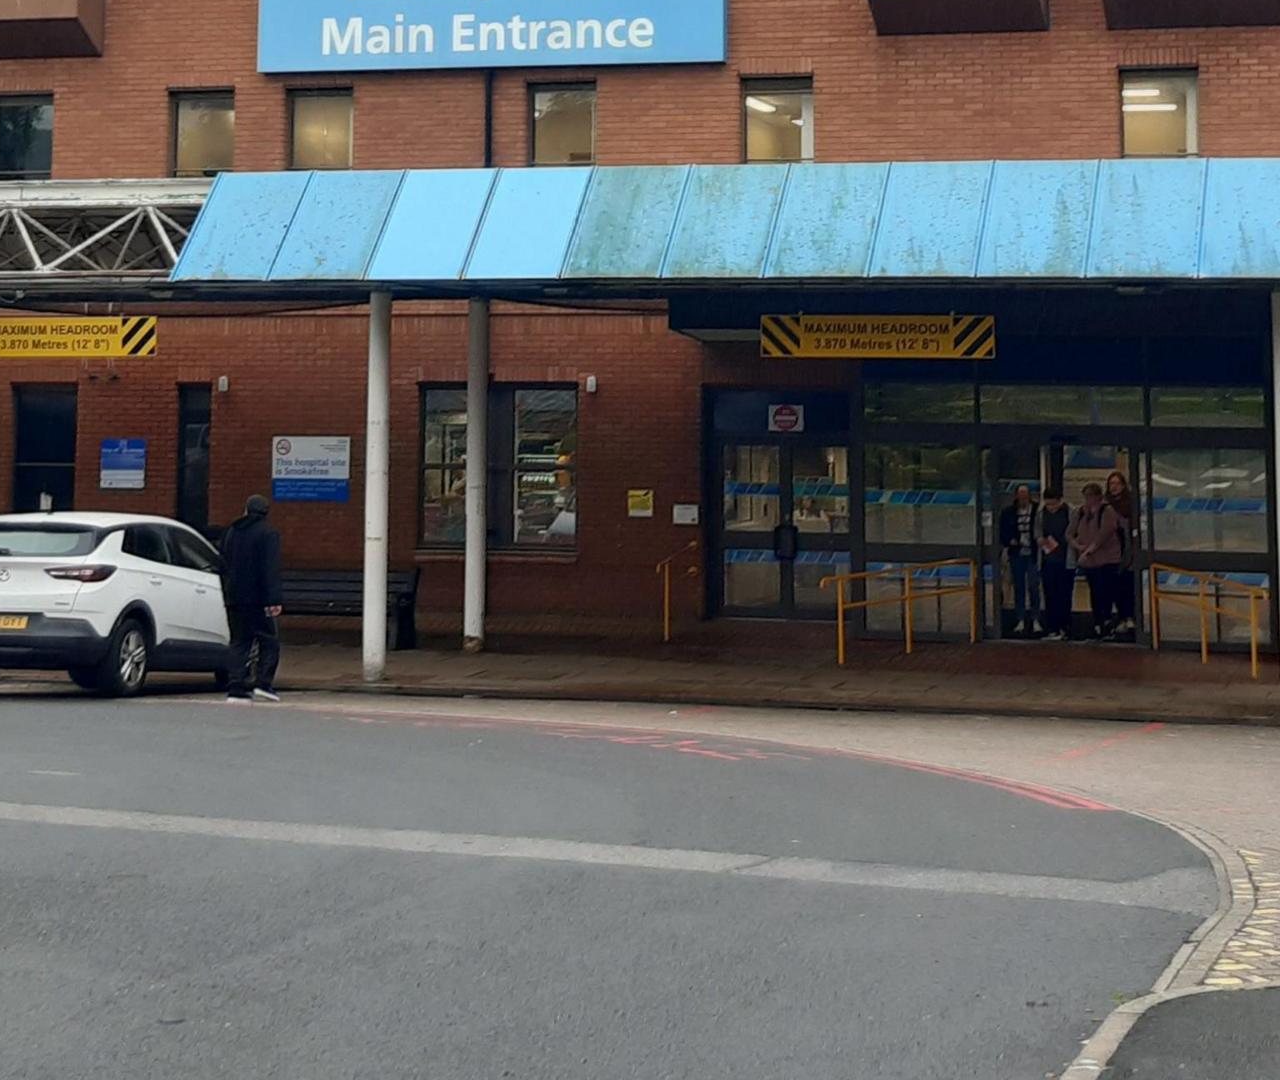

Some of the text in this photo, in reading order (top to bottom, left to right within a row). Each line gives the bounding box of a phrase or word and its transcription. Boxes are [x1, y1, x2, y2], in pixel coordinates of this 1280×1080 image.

[321, 13, 655, 56] Main Entrance
[50, 324, 119, 335] HEADROOM
[803, 322, 950, 335] MAXIMUM HEADROOM
[0, 339, 29, 350] 3.870
[31, 339, 69, 350] Metres
[814, 337, 847, 349] 3.870
[849, 337, 893, 350] Metres
